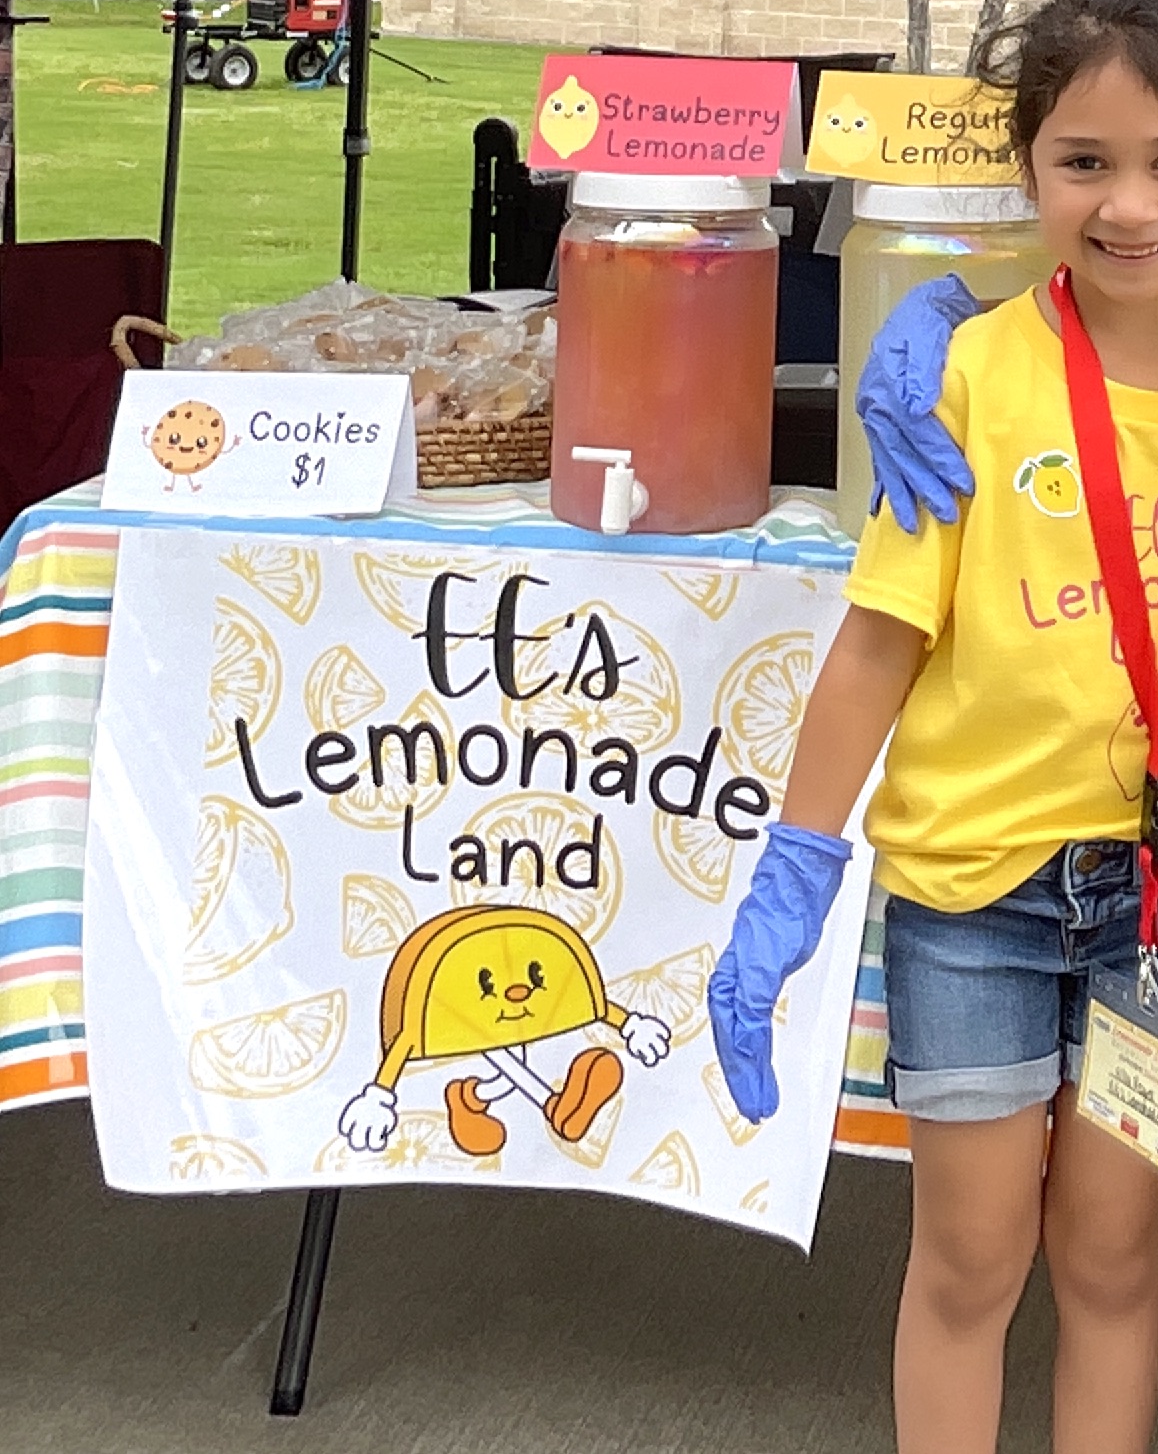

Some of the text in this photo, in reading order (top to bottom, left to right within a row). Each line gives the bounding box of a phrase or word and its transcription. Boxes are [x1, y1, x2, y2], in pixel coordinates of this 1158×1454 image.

[602, 93, 780, 136] Strawberry
[907, 102, 1012, 139] Regul
[607, 129, 766, 163] Lemonade
[250, 411, 381, 445] Cookies
[291, 452, 326, 489] $1
[412, 572, 639, 701] EE's
[235, 718, 770, 841] Lemonade
[402, 804, 603, 889] Land
